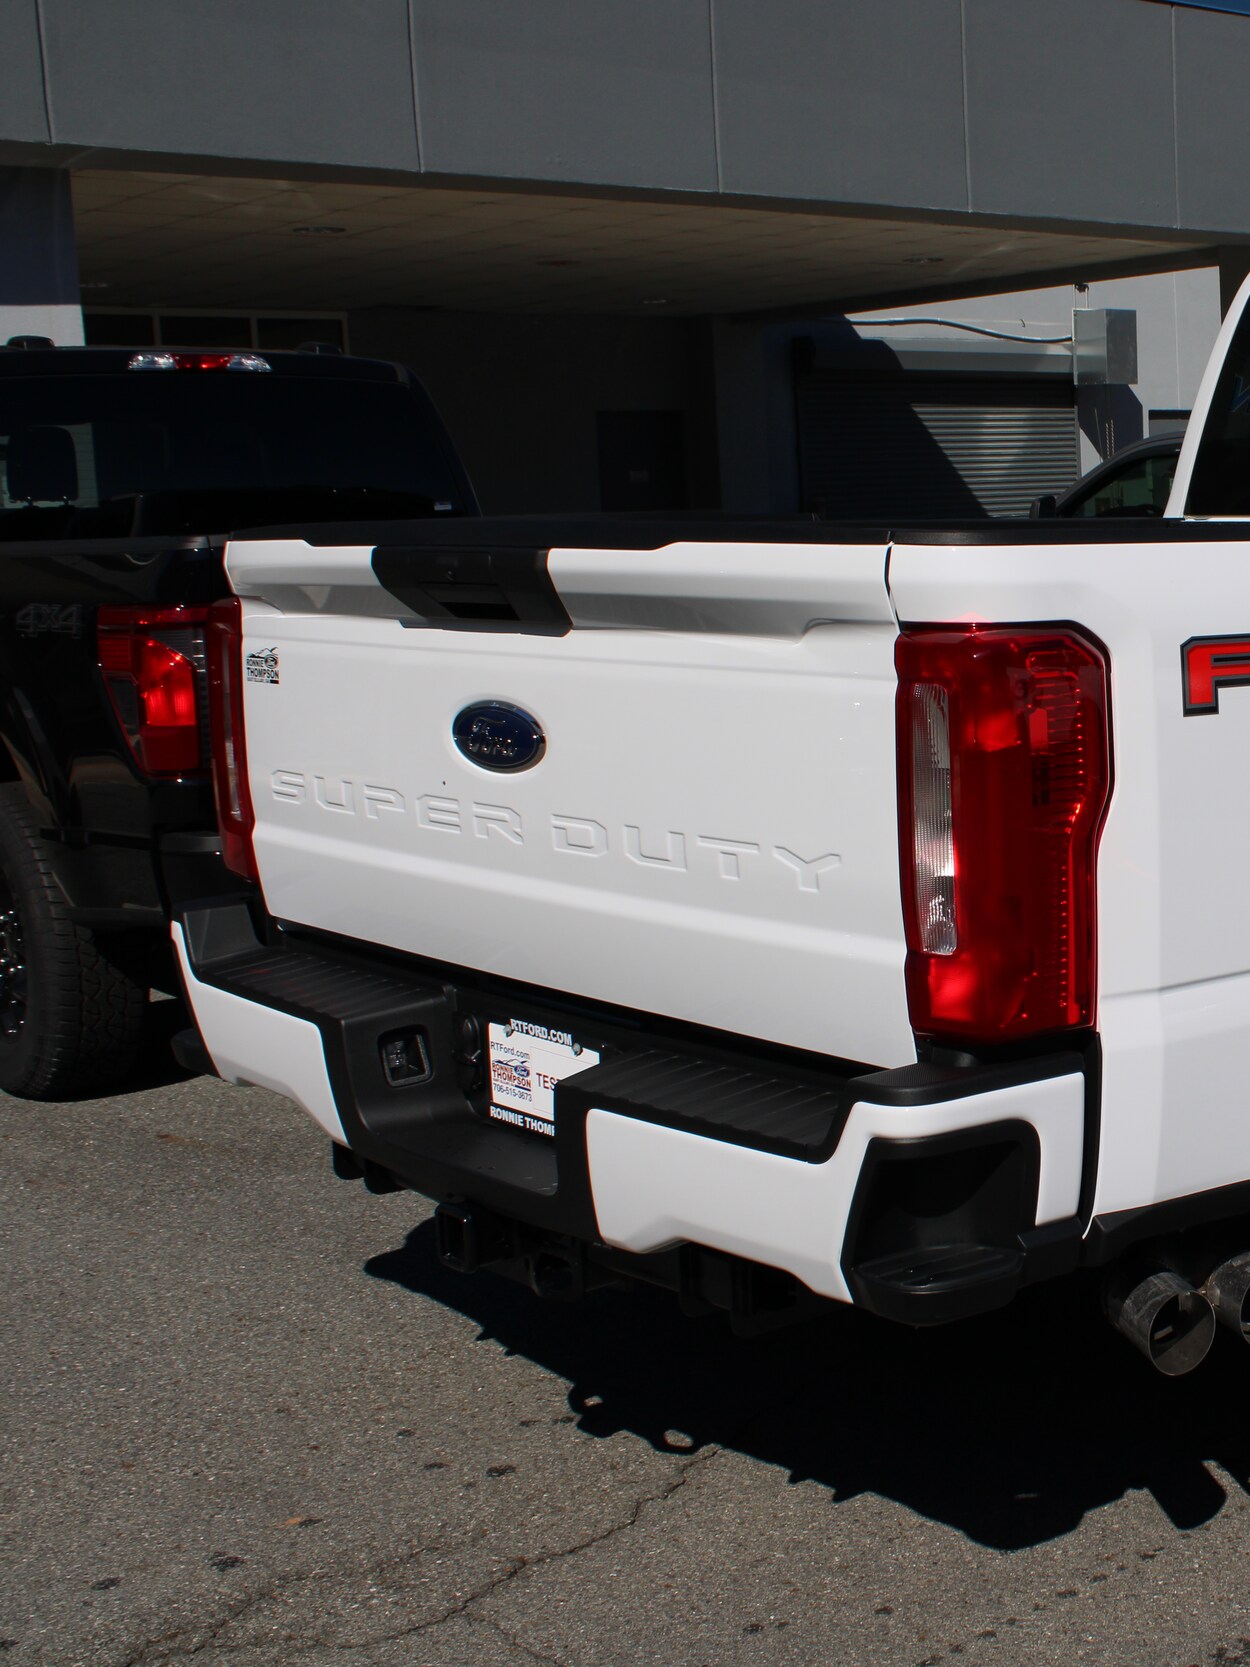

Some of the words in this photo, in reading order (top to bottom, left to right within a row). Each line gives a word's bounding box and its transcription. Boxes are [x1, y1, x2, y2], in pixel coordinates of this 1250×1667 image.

[246, 667, 280, 680] THOMPSON
[270, 769, 523, 845] SUPER
[551, 813, 843, 894] DUTY
[510, 1018, 573, 1047] RTFORD.COM
[490, 1040, 531, 1060] RTFord.com
[492, 1069, 532, 1089] THOMPSON
[489, 1105, 524, 1127] RONNIE
[524, 1116, 555, 1137] THOM
